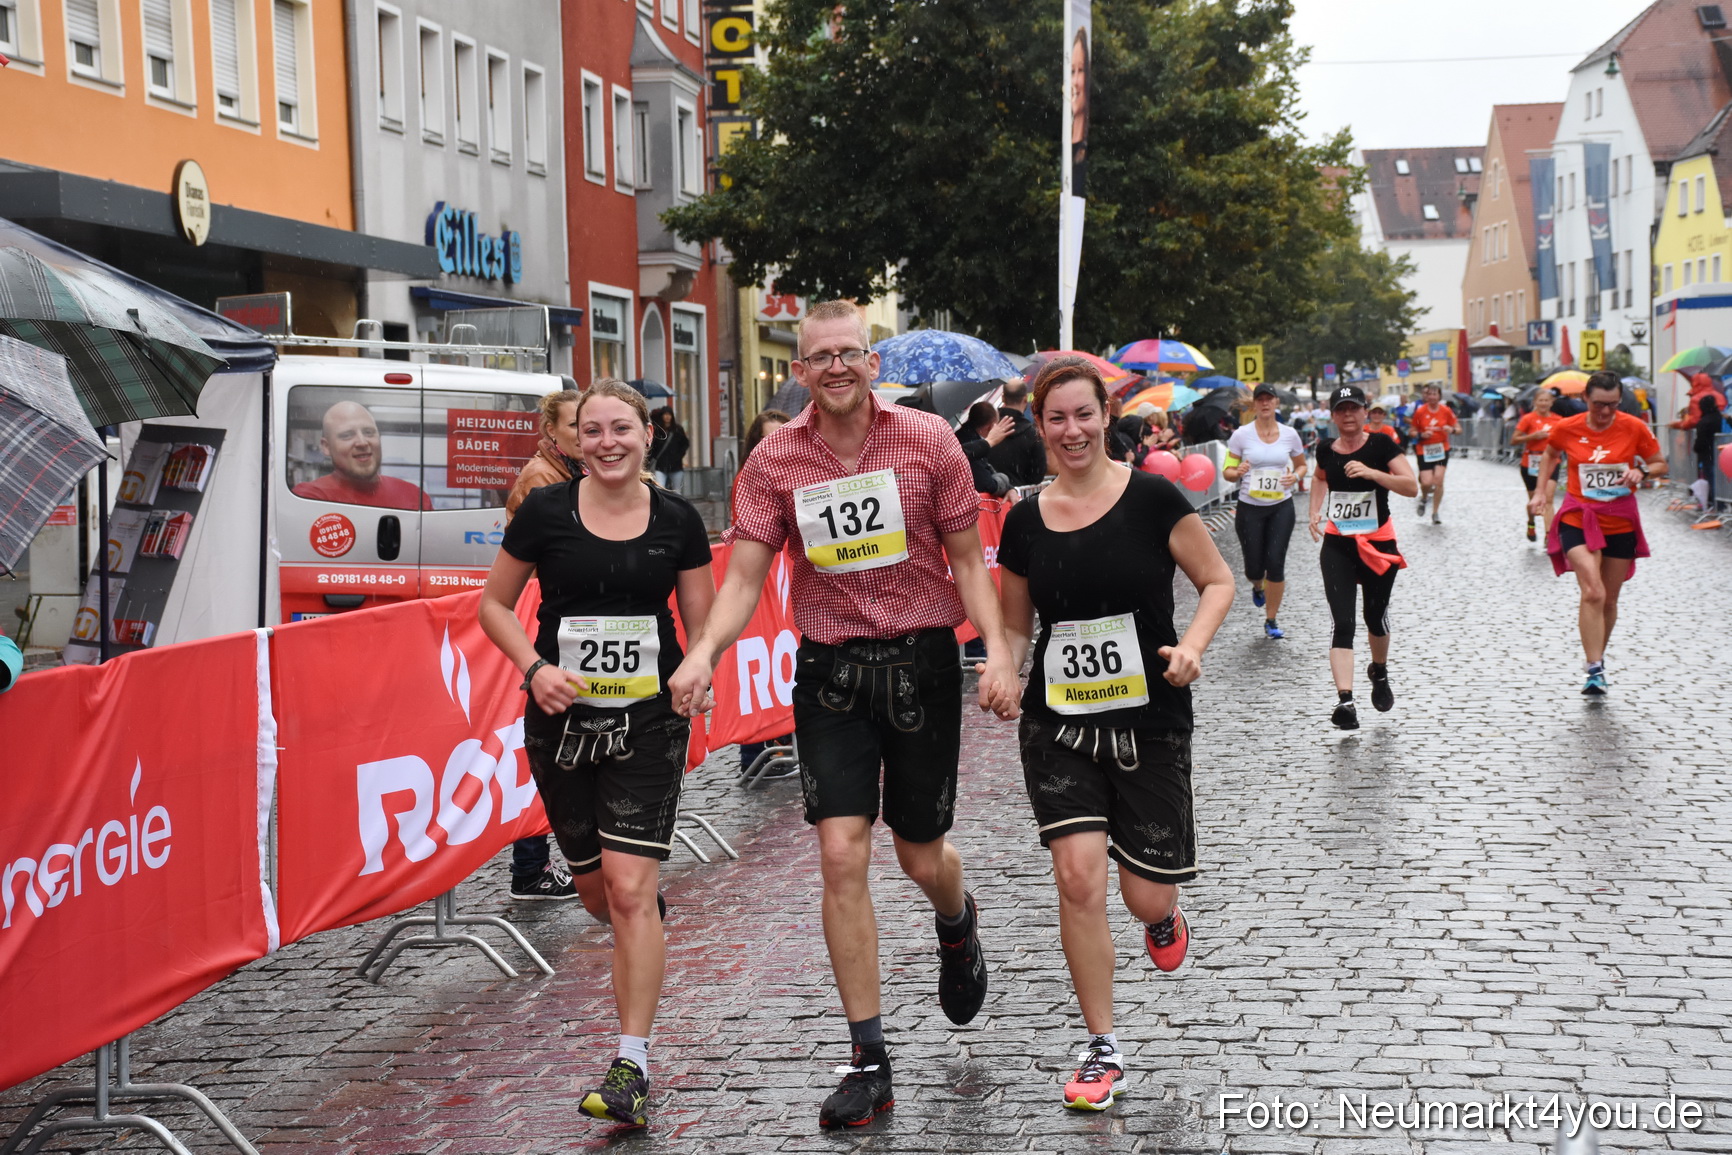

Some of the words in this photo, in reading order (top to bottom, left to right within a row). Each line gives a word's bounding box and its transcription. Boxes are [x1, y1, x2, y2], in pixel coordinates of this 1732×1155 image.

[432, 202, 506, 281] Eilles
[1586, 342, 1599, 361] D
[1243, 357, 1257, 375] D
[456, 417, 533, 431] HEIZUNGEN
[456, 438, 500, 452] BÄDER
[456, 463, 521, 476] Modernisierung
[456, 476, 473, 484] und
[474, 476, 507, 485] Neubau
[836, 474, 888, 494] BOCK
[1258, 477, 1279, 490] 137
[802, 492, 833, 504] NeuerMarkt
[818, 496, 885, 540] 132
[1333, 500, 1372, 519] 3057
[316, 535, 328, 544] 48
[327, 532, 339, 541] 48
[339, 528, 350, 537] 48
[835, 542, 880, 562] Martin
[330, 573, 361, 584] 09181
[362, 574, 376, 584] 48
[430, 576, 459, 586] 92318
[604, 619, 651, 632] BOCK
[1080, 618, 1126, 636] BOCK
[579, 639, 641, 674] 255
[1062, 640, 1123, 679] 336
[590, 681, 626, 695] Karin
[1065, 684, 1129, 702] Alexandra
